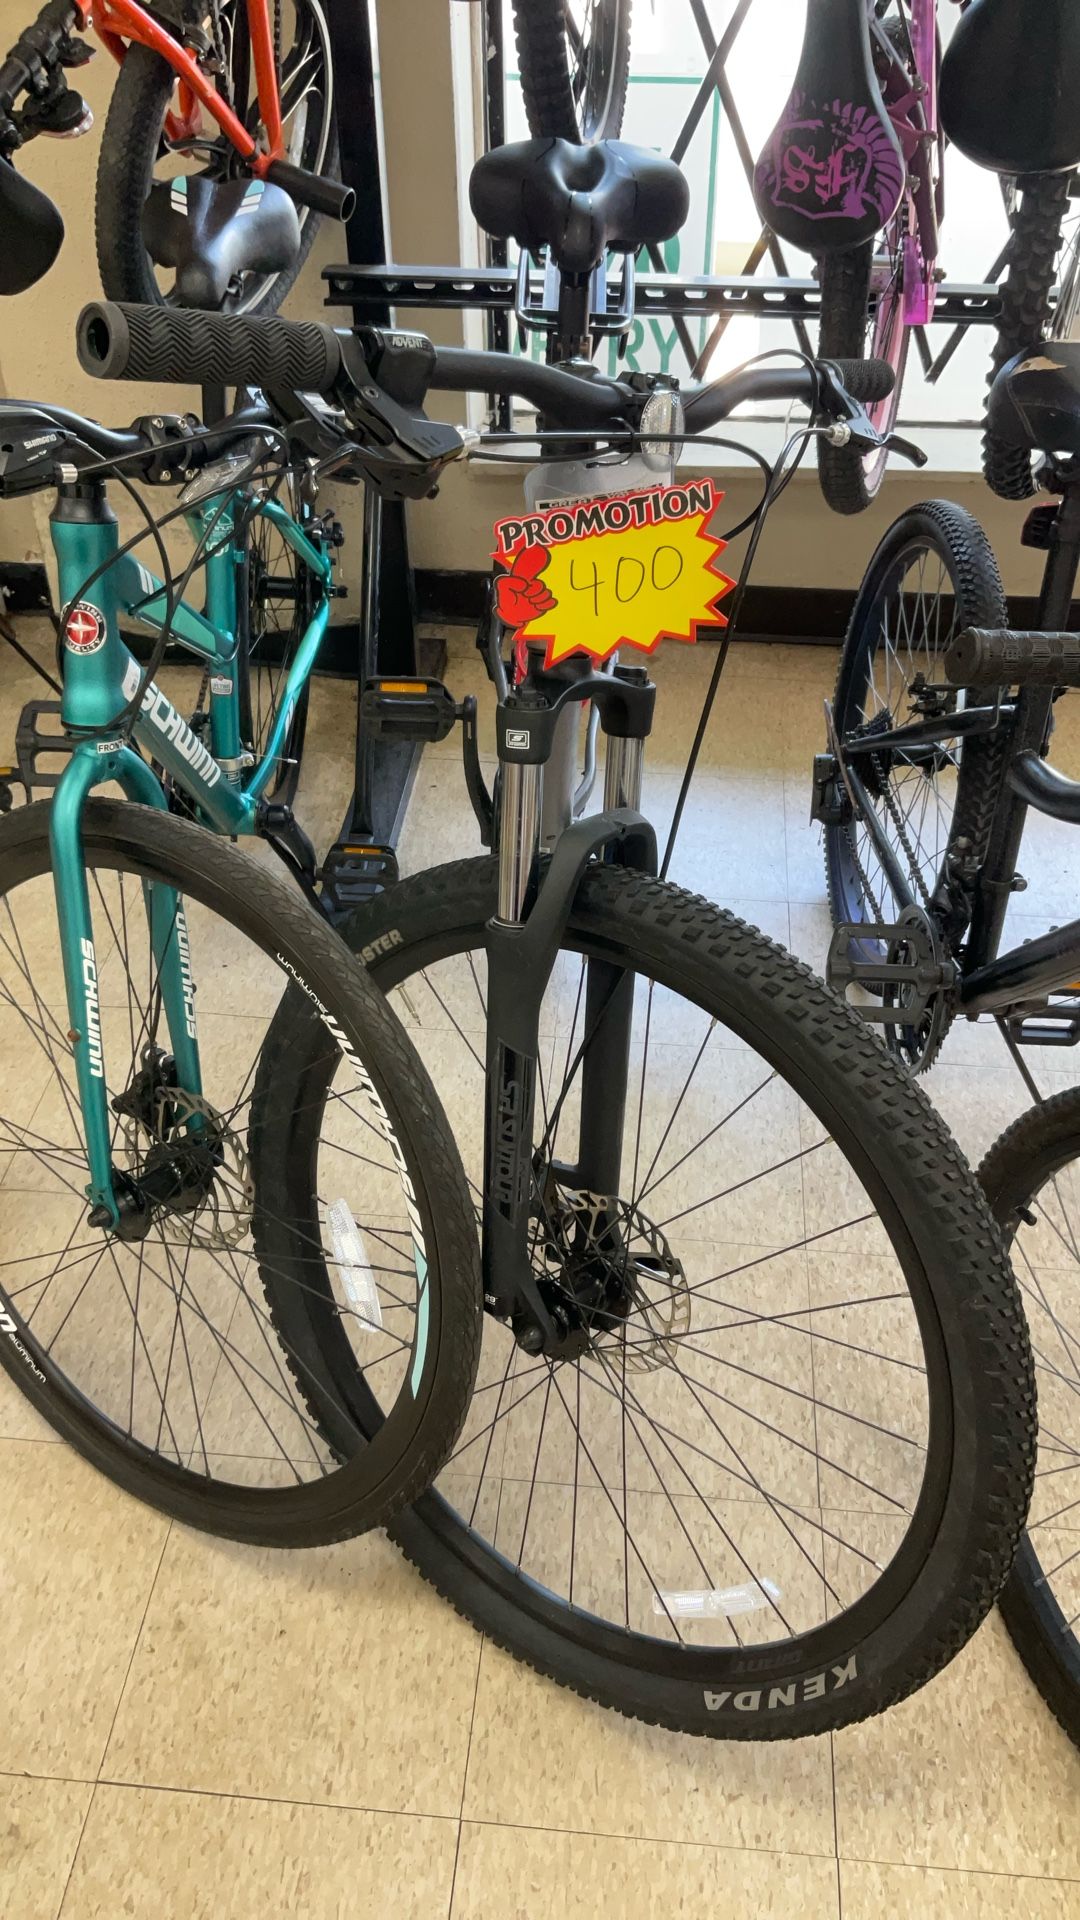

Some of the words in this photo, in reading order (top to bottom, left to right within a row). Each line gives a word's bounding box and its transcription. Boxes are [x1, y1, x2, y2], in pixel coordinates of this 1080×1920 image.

[23, 433, 57, 450] SHIMANO
[499, 482, 713, 552] PROMOTION
[570, 545, 683, 616] 400
[98, 739, 123, 752] FRONT
[140, 681, 222, 789] SCHWINN
[80, 936, 104, 1078] SCHWINN
[174, 911, 198, 1040] SCHWINN
[8, 1333, 47, 1384] aluminum
[703, 1653, 858, 1711] KENDA
